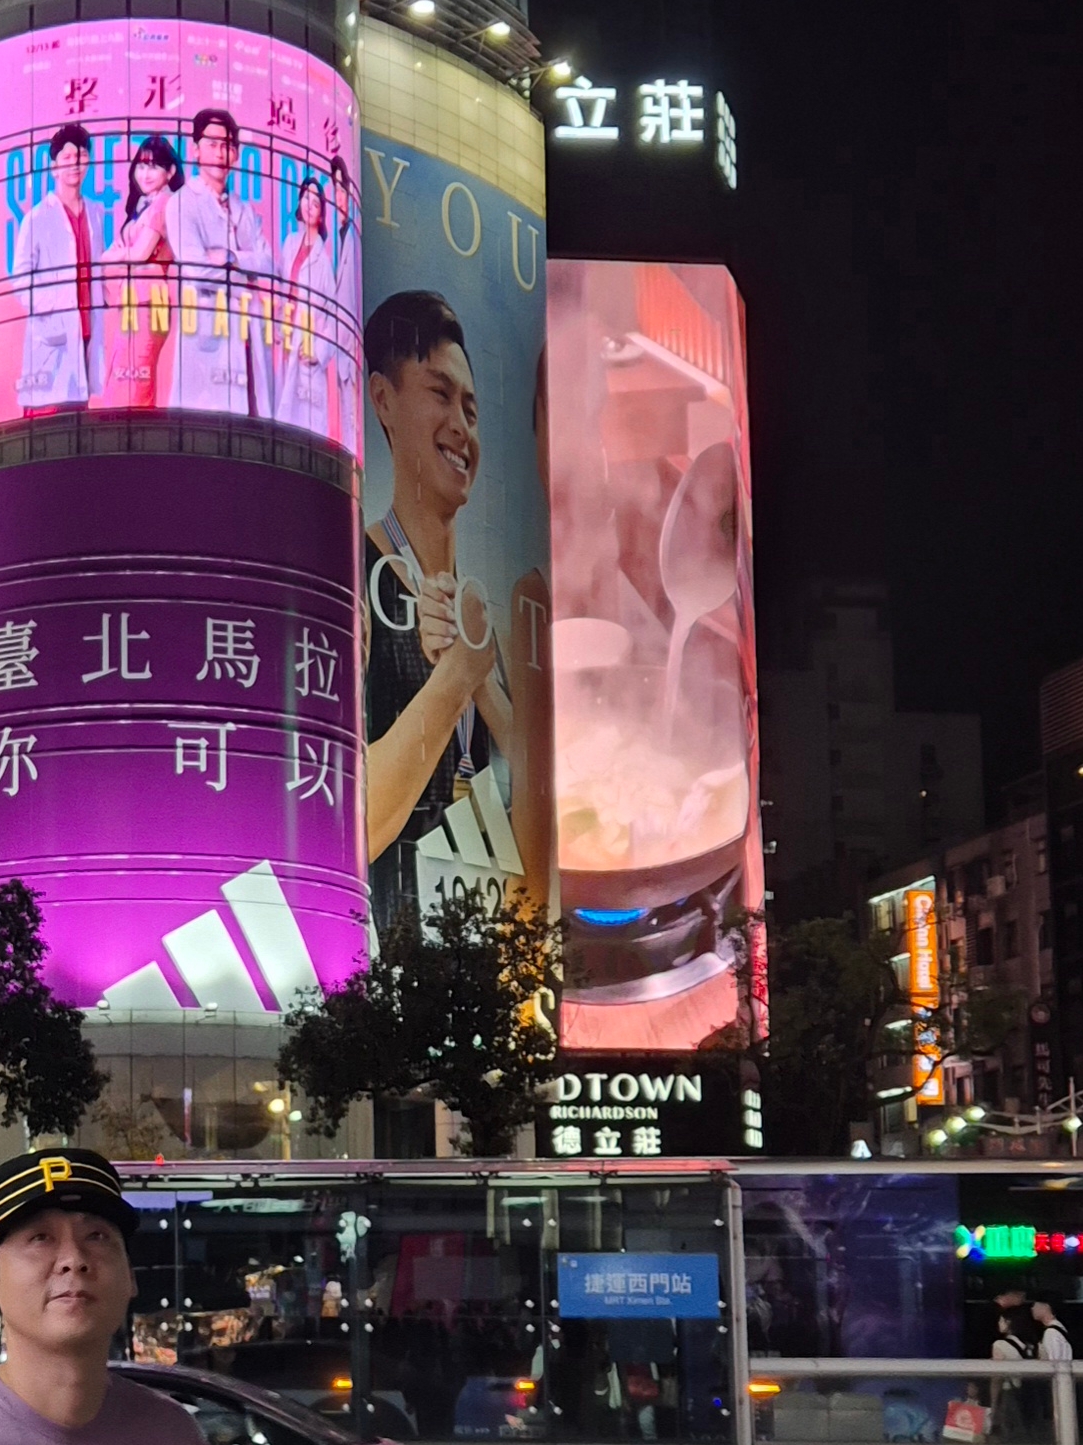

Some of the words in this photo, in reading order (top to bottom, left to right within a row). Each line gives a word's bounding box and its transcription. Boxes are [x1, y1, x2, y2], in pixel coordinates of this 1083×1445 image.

[64, 73, 341, 155] 整形過後
[512, 74, 705, 144] 立莊
[364, 146, 540, 291] YOU
[369, 553, 548, 672] GOT
[549, 1105, 659, 1120] RICHARDSON
[552, 1126, 662, 1156] 德立莊
[39, 1156, 73, 1193] P
[585, 1272, 692, 1294] 捷運西門站
